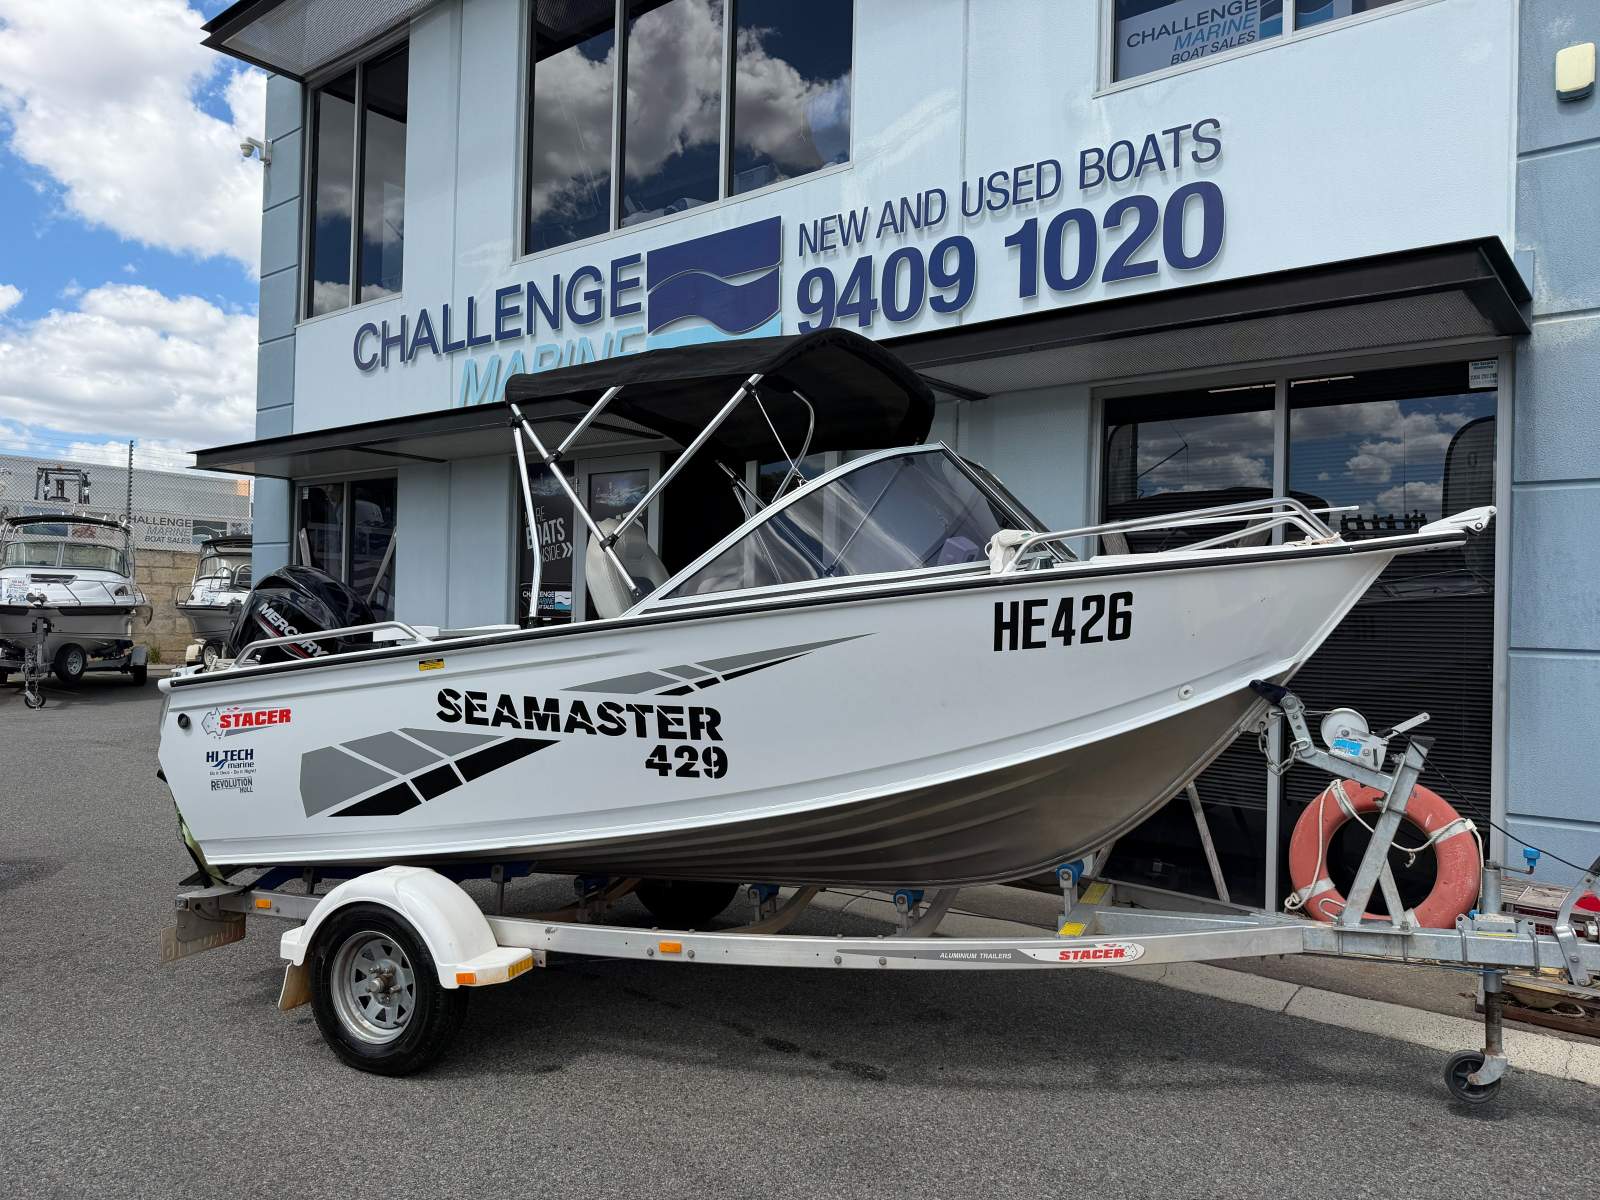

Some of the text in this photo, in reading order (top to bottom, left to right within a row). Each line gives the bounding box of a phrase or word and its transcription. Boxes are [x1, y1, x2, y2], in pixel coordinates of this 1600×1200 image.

[1126, 0, 1258, 48] CHALLENGE
[1174, 10, 1258, 51] MARINE
[1170, 30, 1256, 65] BOAT SALES
[798, 118, 1221, 257] NEW AND USED BOATS
[796, 181, 1226, 334] 9409 1020
[353, 253, 643, 371] CHALLENGE
[144, 535, 167, 544] BOAT
[146, 525, 192, 538] MARINE
[258, 602, 330, 658] MERCRY
[994, 591, 1133, 652] HE426
[220, 708, 292, 728] STACER
[435, 687, 724, 742] SEAMASTER
[206, 748, 254, 763] HI TECH
[227, 761, 255, 769] marine
[645, 744, 729, 780] 429
[210, 778, 253, 791] REVOLUTION
[939, 952, 977, 960] ALUMINIUM
[1058, 948, 1126, 961] STACER
